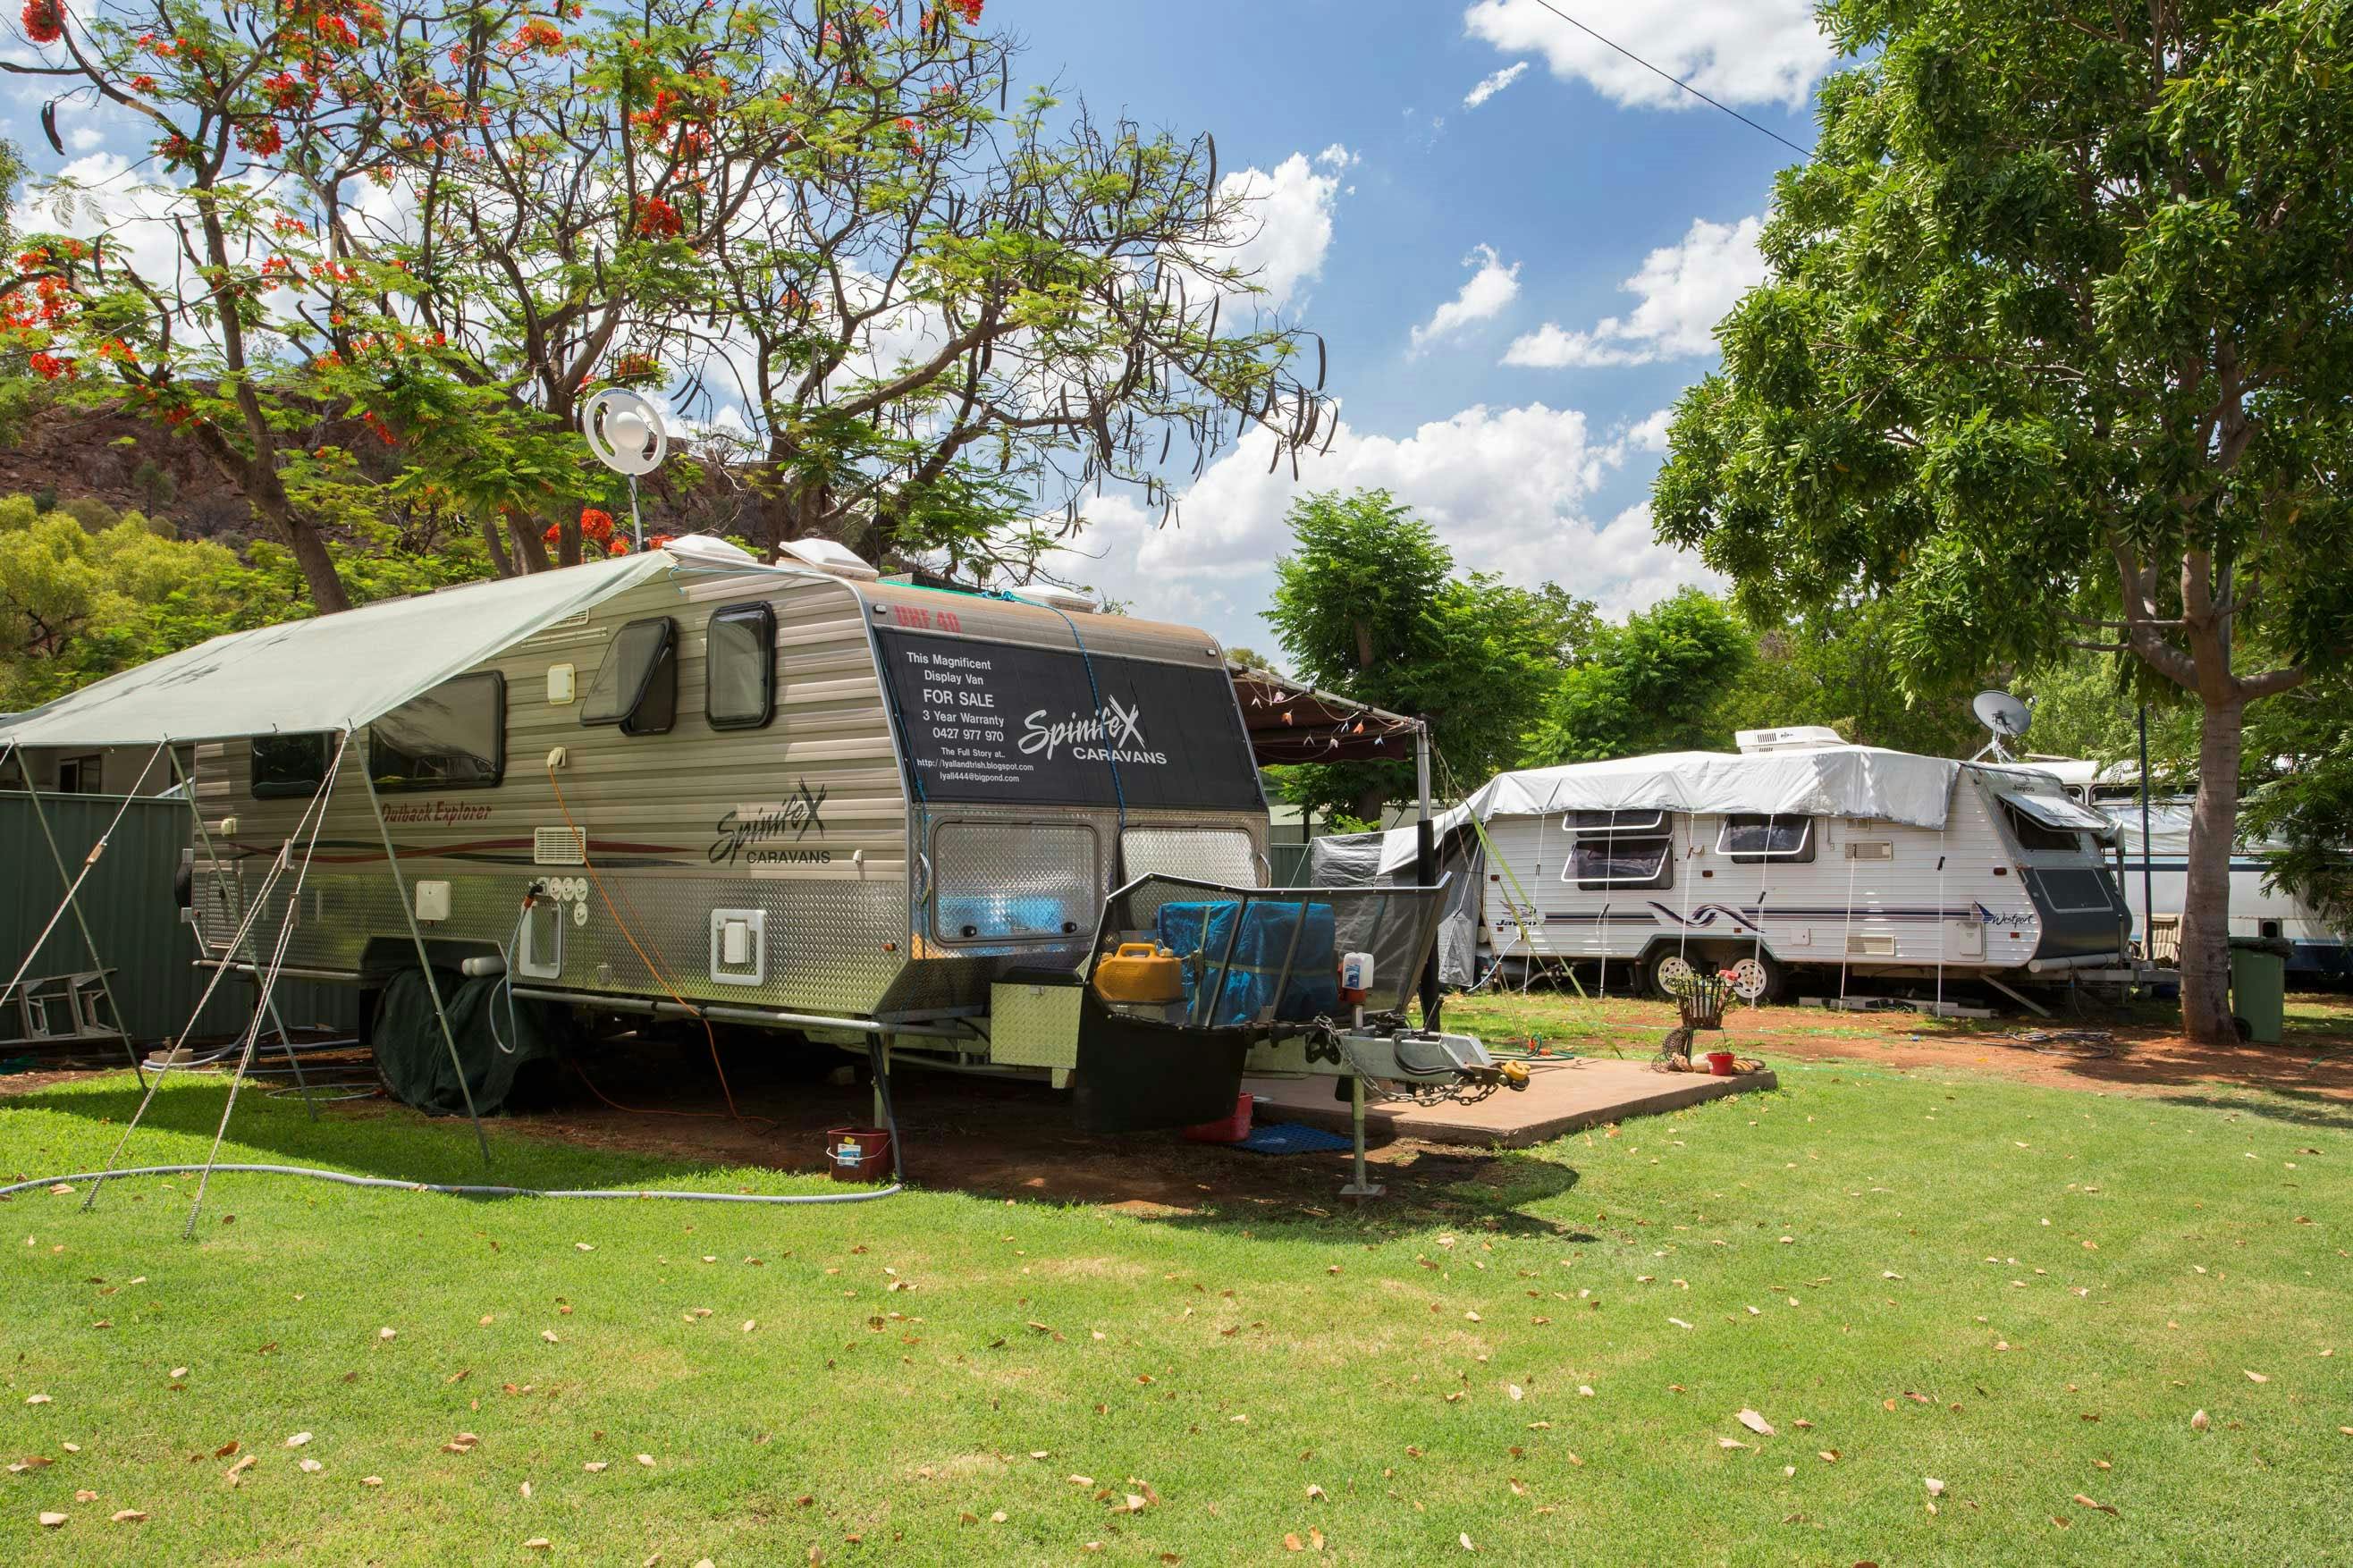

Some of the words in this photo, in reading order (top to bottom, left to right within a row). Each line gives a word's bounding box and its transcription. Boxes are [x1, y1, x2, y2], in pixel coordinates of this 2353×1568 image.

[907, 652, 929, 664] This
[932, 653, 991, 670] Magnificent
[924, 670, 962, 685] Display
[966, 674, 984, 685] Van
[923, 688, 954, 704] FOR
[958, 691, 995, 708] SALE
[923, 710, 931, 721] 3
[933, 711, 957, 722] Year
[960, 712, 1005, 728] Warranty
[932, 727, 959, 739] 0427
[963, 729, 981, 741] 977
[984, 730, 1004, 742] 970
[940, 746, 955, 756] The
[957, 748, 971, 756] Full
[973, 748, 992, 759] Story
[1073, 746, 1168, 764] CARAVANS
[940, 771, 1020, 783] lyall444@bigpond.com
[2011, 784, 2036, 793] Jayco
[383, 802, 433, 822] Outback
[434, 801, 493, 827] Explorer
[746, 850, 831, 864] CARAVANS
[1992, 913, 2034, 929] Westport
